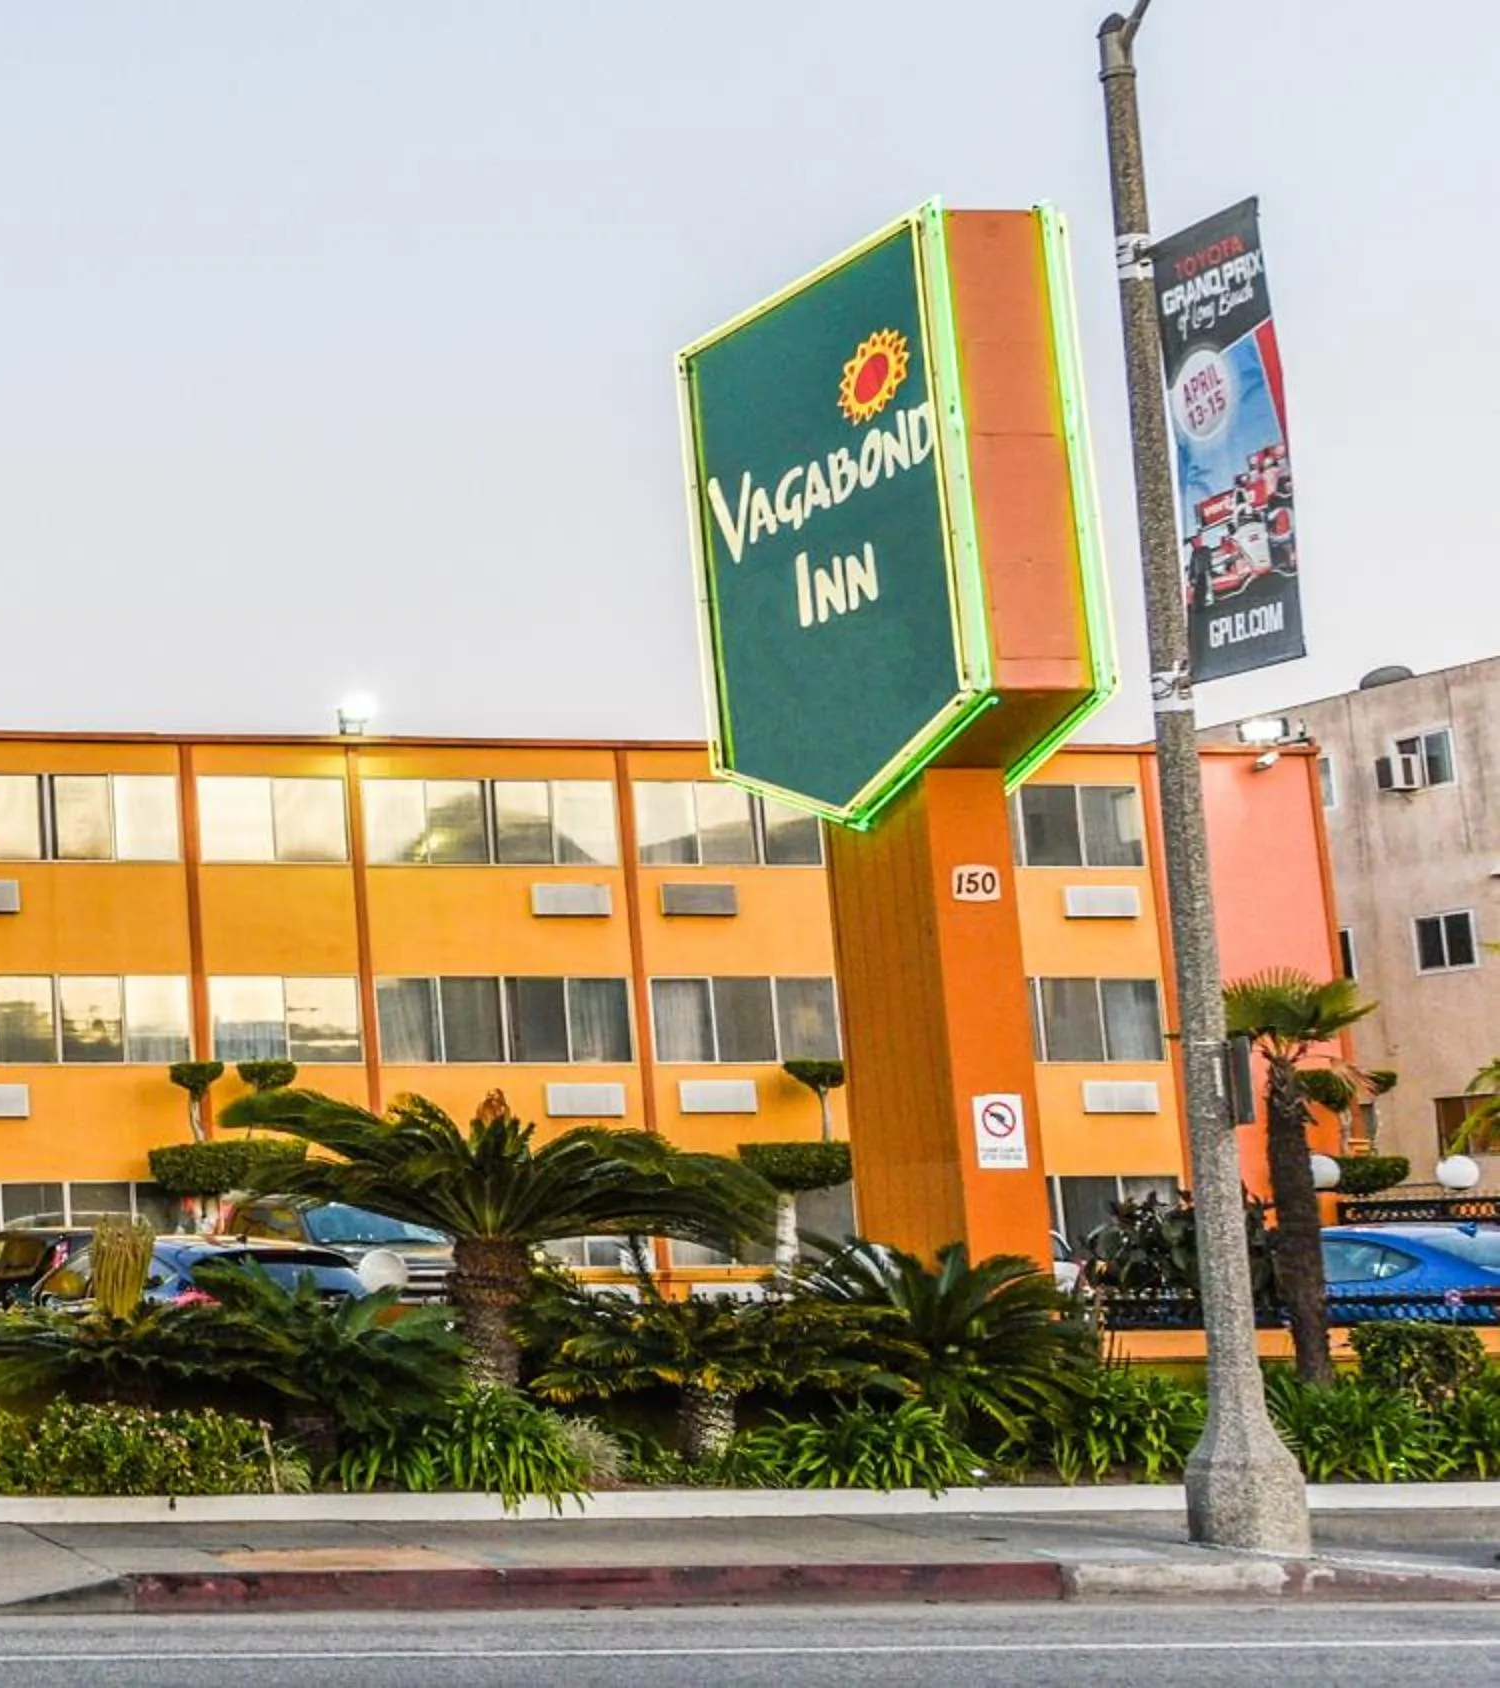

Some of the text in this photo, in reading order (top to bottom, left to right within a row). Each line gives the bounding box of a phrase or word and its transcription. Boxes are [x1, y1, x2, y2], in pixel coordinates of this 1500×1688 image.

[1173, 235, 1246, 280] TOYOTA
[1161, 248, 1263, 317] GRAND PRIX
[1183, 363, 1223, 408] APRIL
[1187, 390, 1227, 429] 13-15
[707, 401, 935, 564] VAGABOND
[796, 541, 880, 628] INN
[1209, 601, 1284, 648] GPLB.COM
[956, 871, 996, 895] 150
